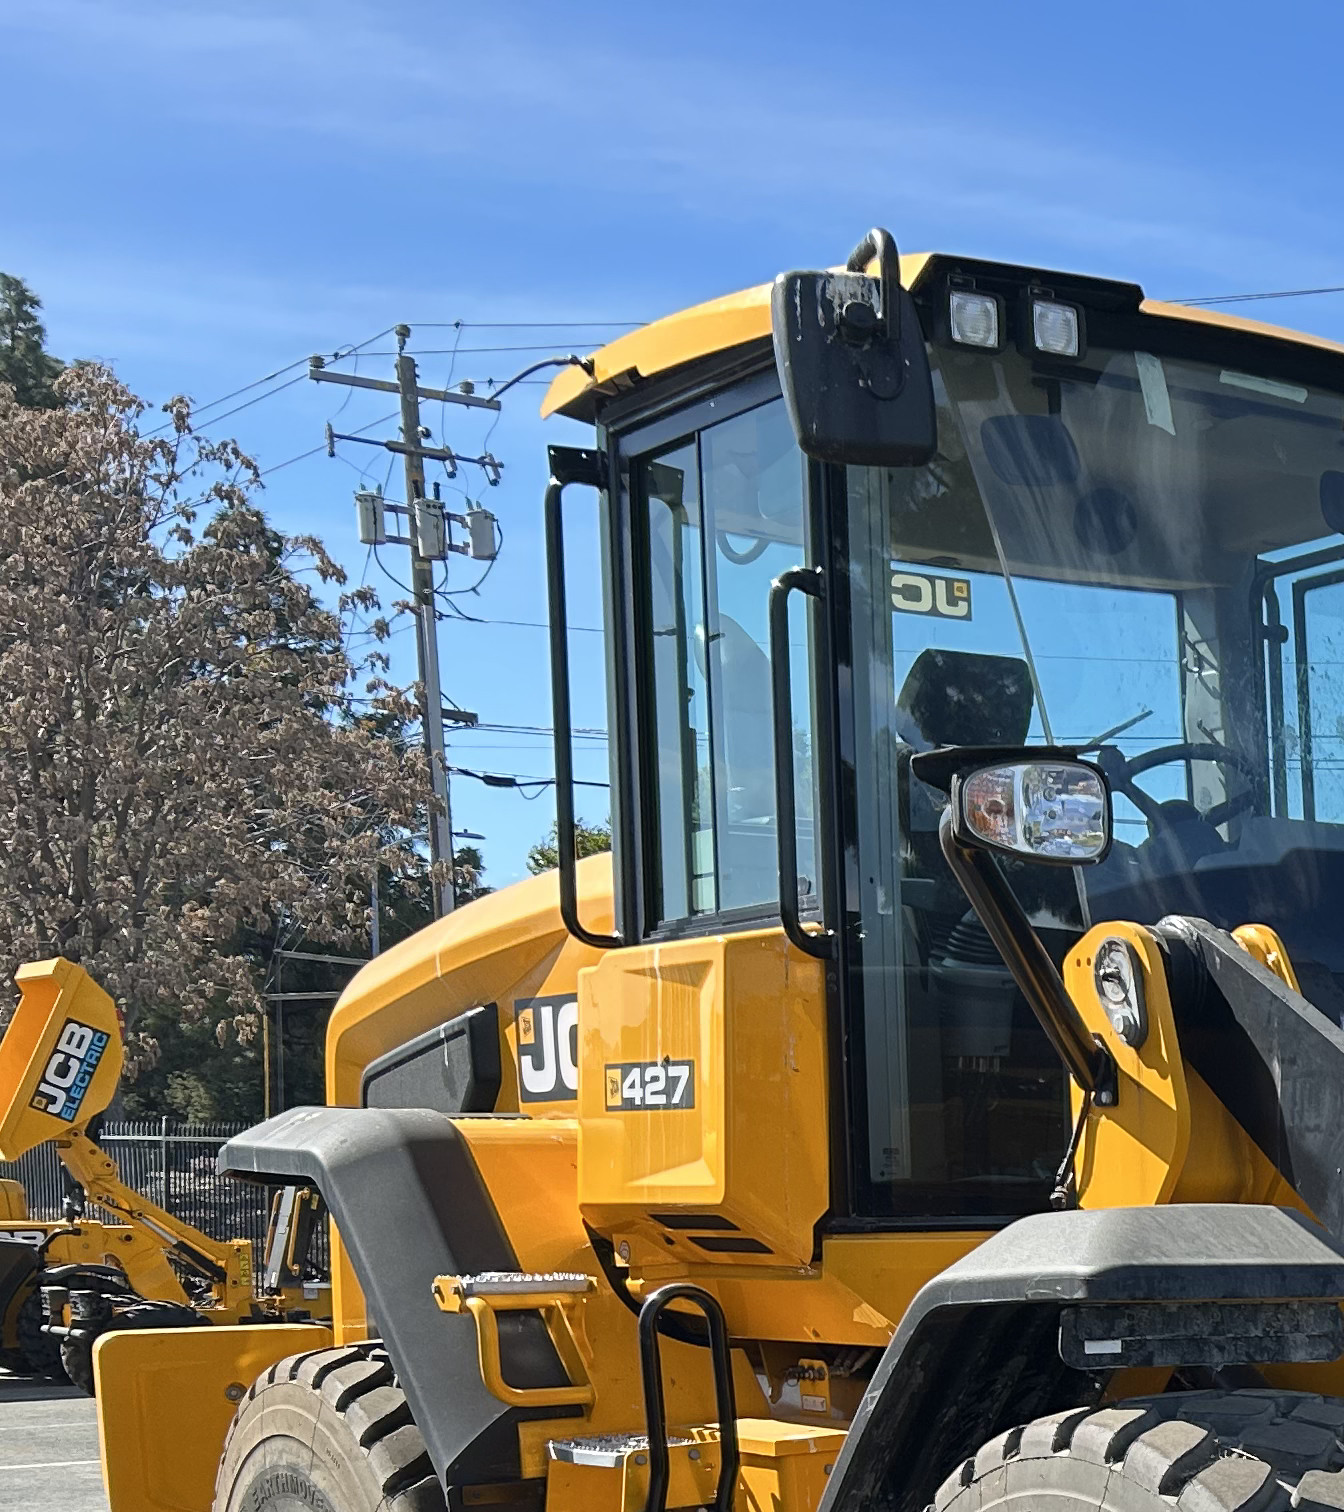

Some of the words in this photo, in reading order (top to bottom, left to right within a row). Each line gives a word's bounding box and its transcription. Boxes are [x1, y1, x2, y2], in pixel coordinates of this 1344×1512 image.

[39, 1022, 94, 1114] JCB
[61, 1032, 108, 1120] ELECTRIC
[521, 1002, 578, 1093] JC
[622, 1065, 690, 1105] 427
